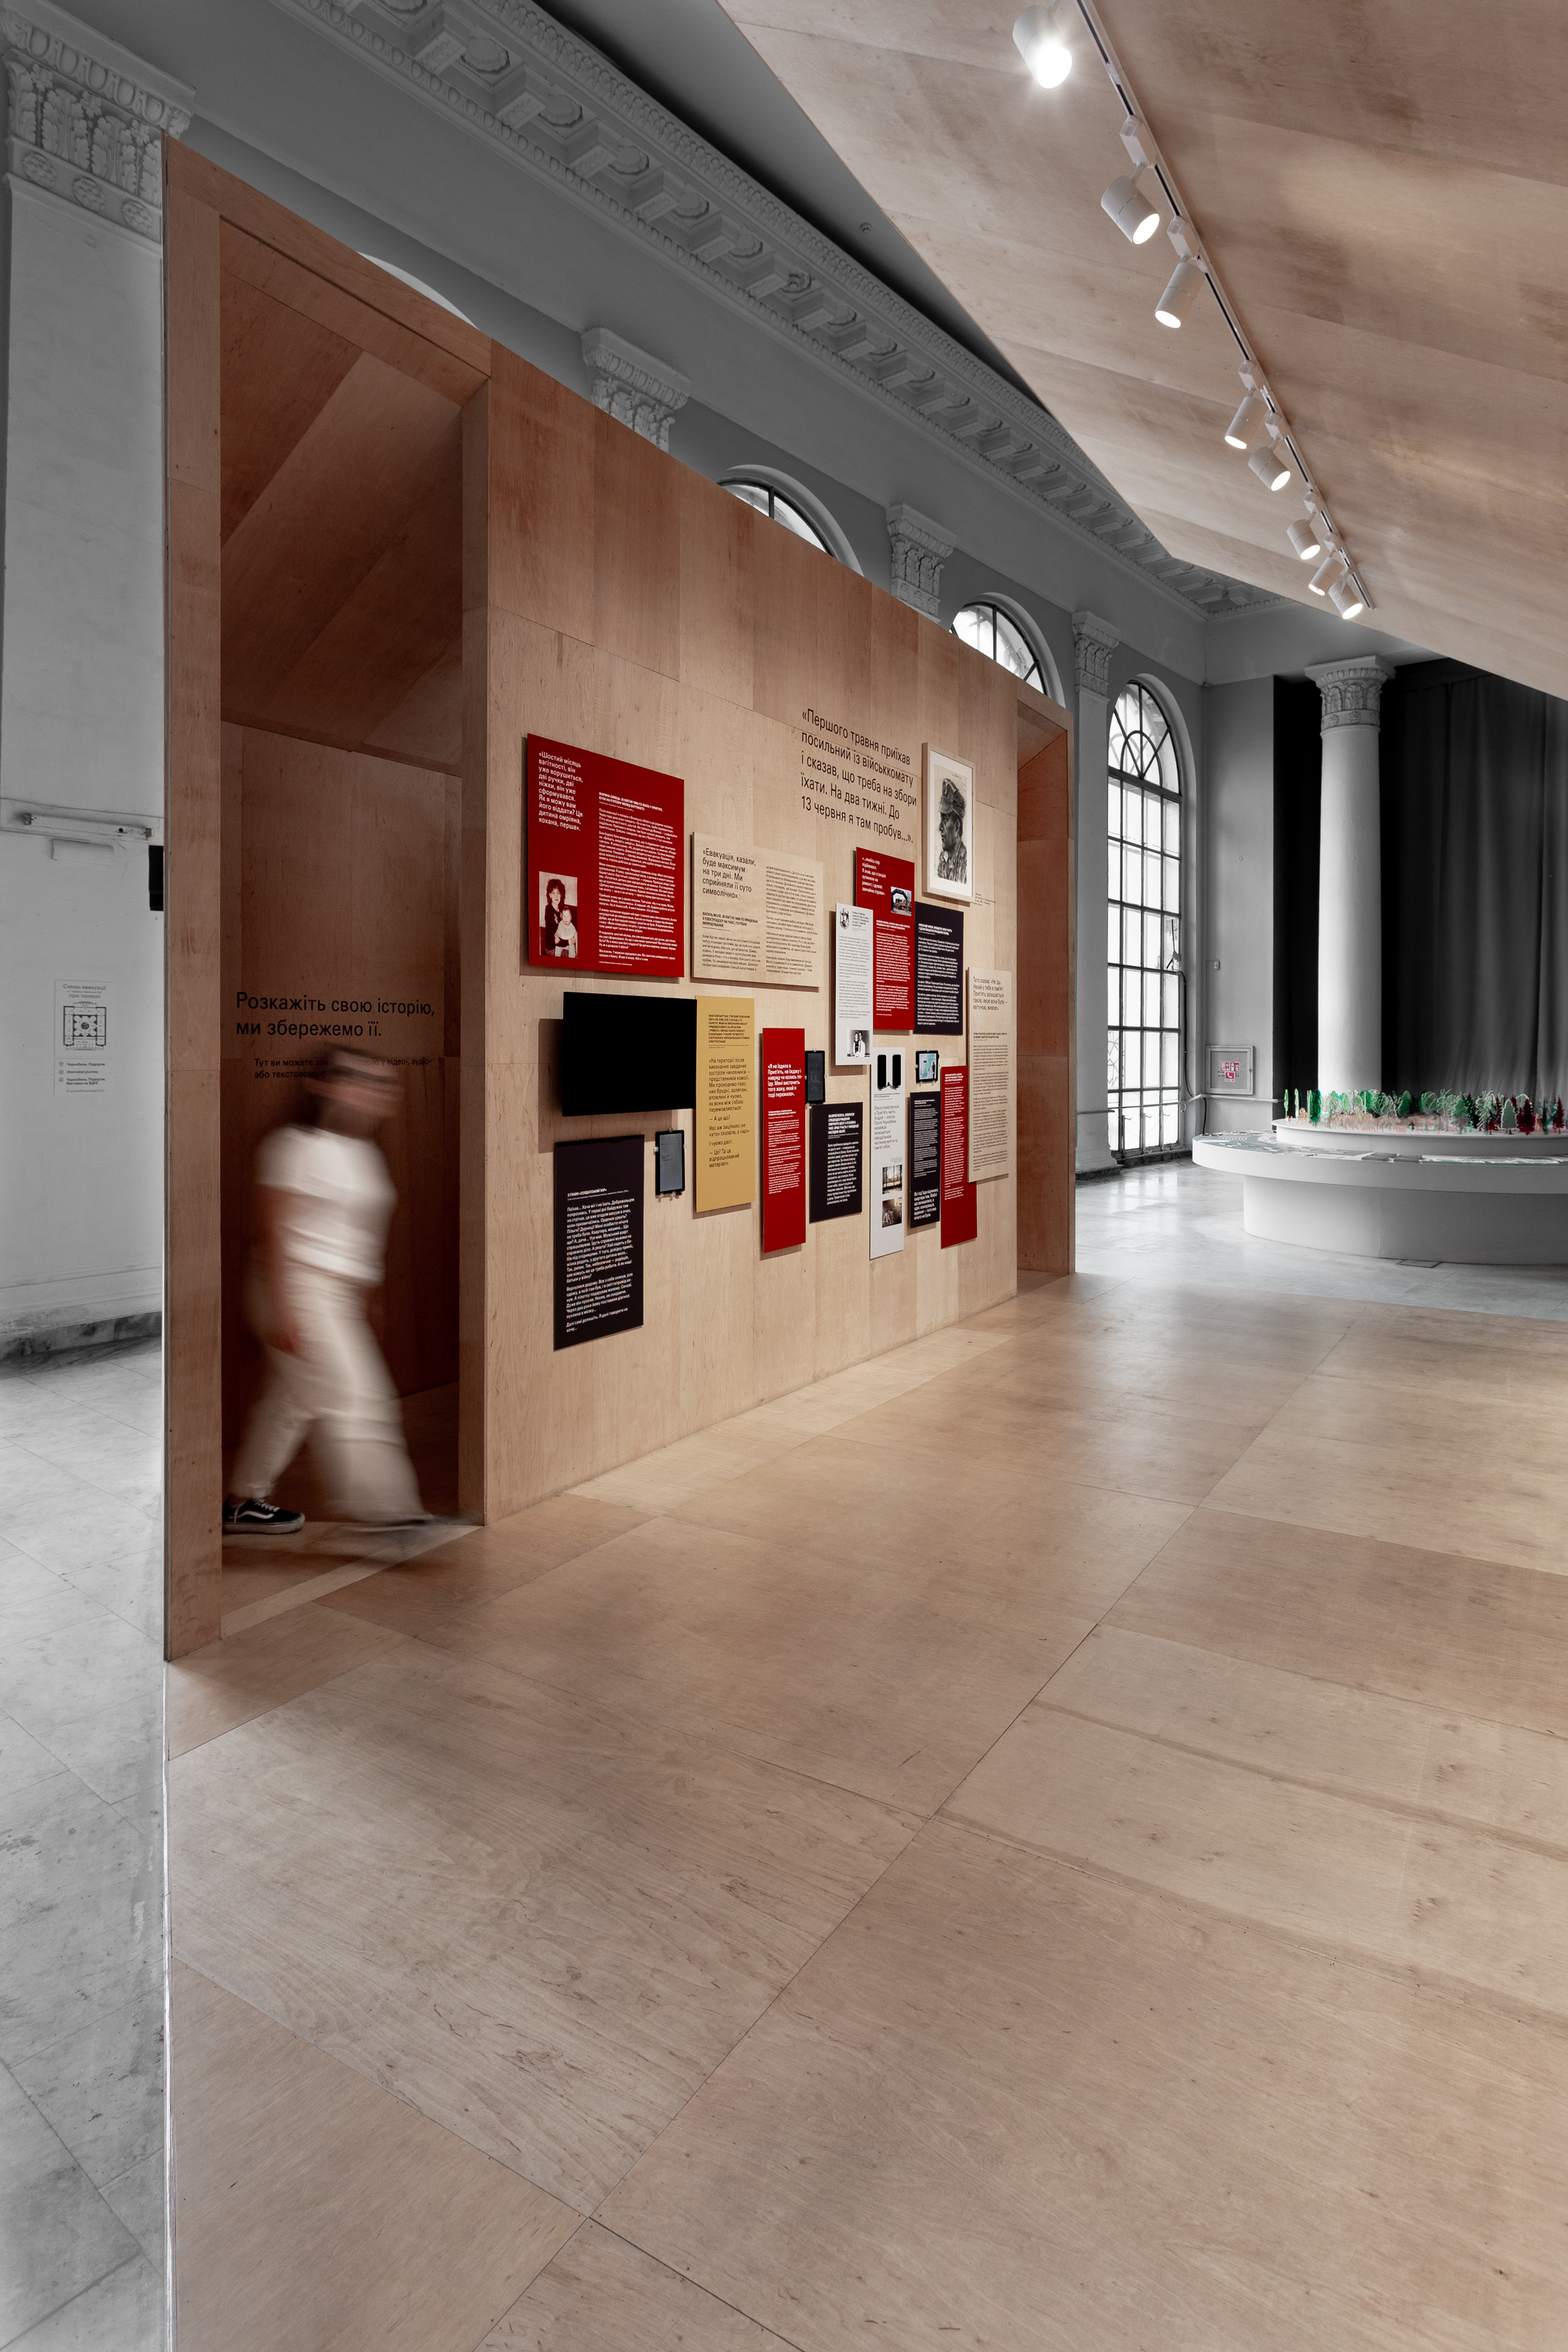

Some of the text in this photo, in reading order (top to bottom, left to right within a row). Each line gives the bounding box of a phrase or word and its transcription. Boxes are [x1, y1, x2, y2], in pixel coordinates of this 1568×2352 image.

[802, 709, 910, 765] «Першого травня приїхав
[539, 751, 581, 768] «Шостий місяць
[539, 759, 567, 771] вагітності,
[802, 732, 913, 788] посильний із військкомату
[548, 776, 564, 785] ручки,
[550, 770, 583, 782] ворушиться,
[807, 757, 839, 779] сказав,
[842, 770, 855, 783] що
[857, 775, 880, 793] треба
[884, 786, 891, 797] на
[895, 789, 916, 807] збори
[539, 780, 555, 790] ніжки,
[539, 788, 575, 801] сформувався.
[800, 772, 899, 820] їхати. На два тижні. До
[553, 805, 575, 815] віддати?
[559, 815, 581, 825] омріяна,
[802, 796, 811, 811] 13
[815, 803, 846, 822] червня
[856, 816, 870, 829] там
[874, 822, 913, 843] пробув...».
[703, 848, 756, 866] «Евакуація, казали,
[702, 857, 745, 873] буде максимум
[702, 878, 733, 888] сприйняли
[735, 873, 742, 881] Ми
[237, 992, 434, 1017] Розкажіть свою історію,
[237, 1019, 381, 1039] ми збережемо її.
[283, 1058, 314, 1069] можете
